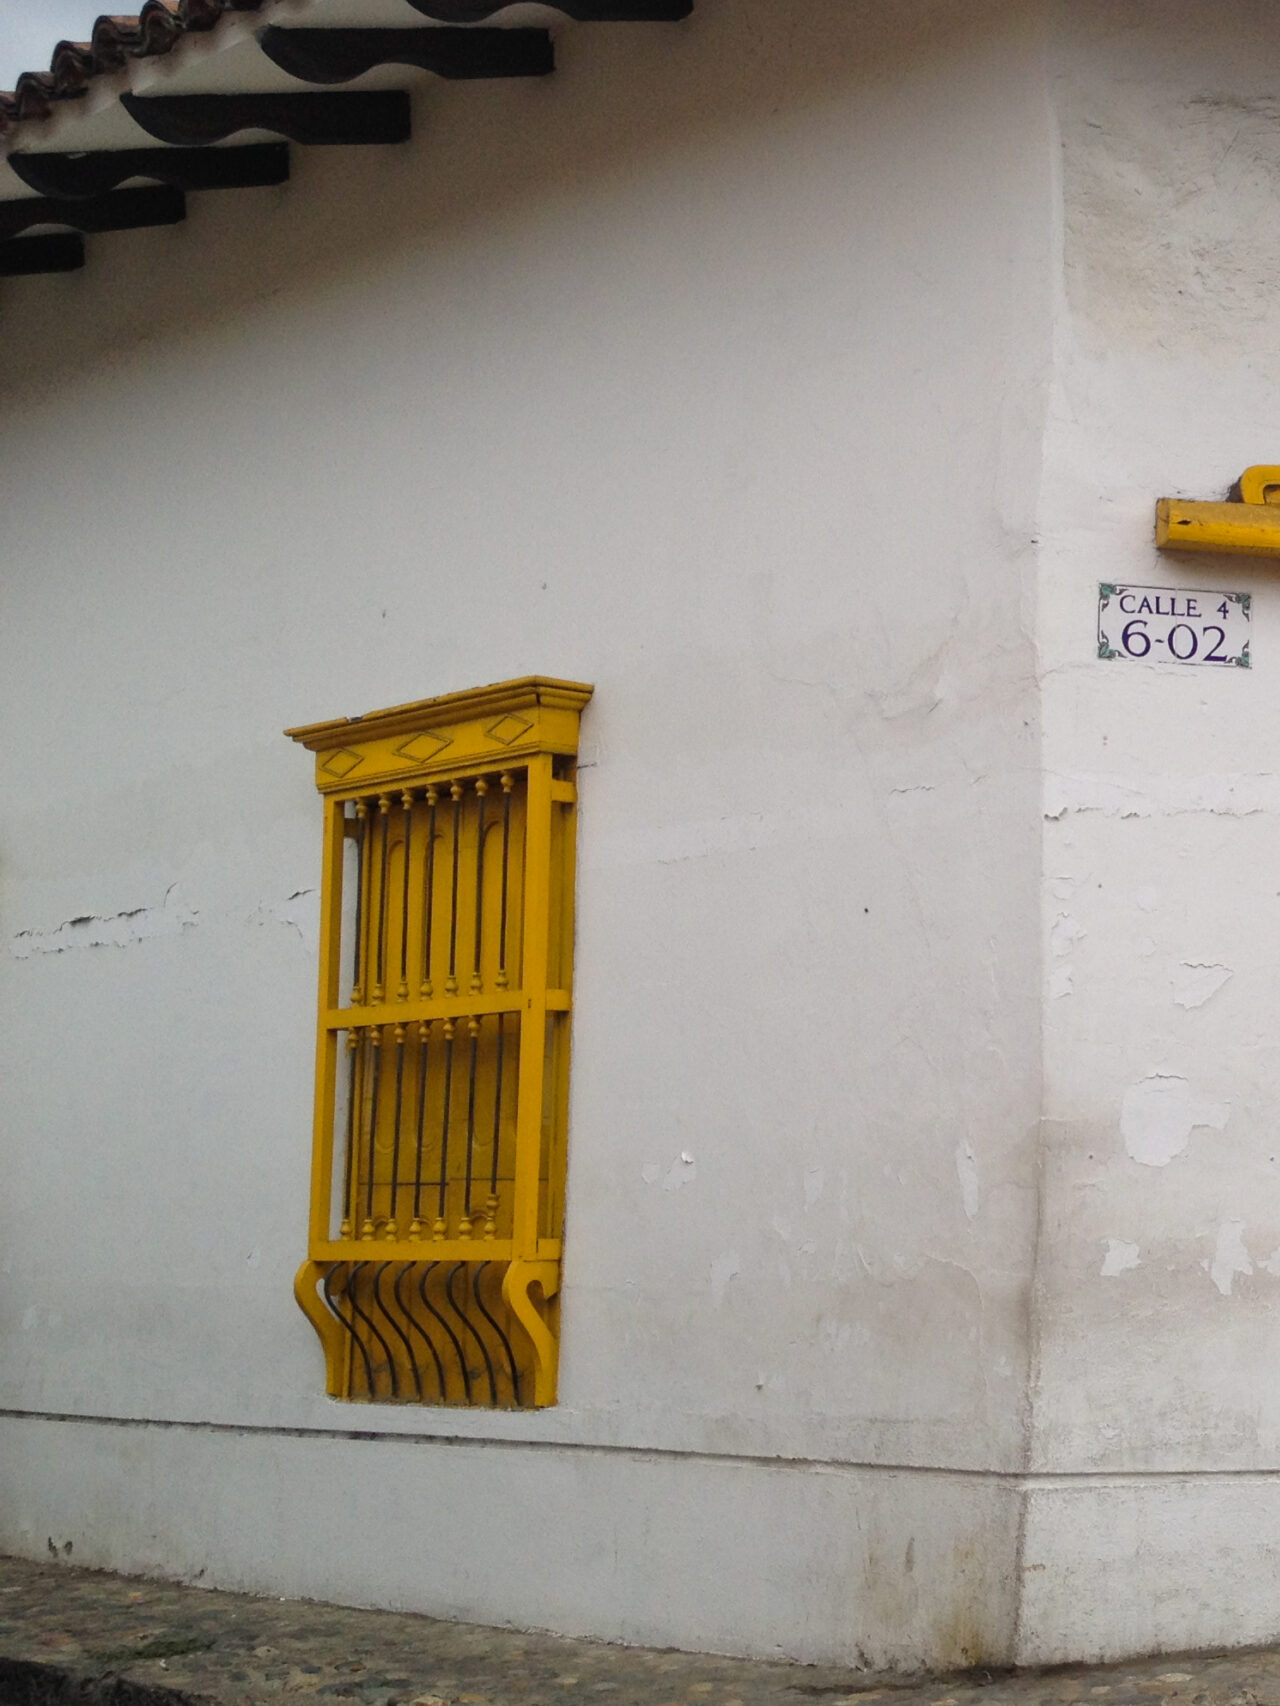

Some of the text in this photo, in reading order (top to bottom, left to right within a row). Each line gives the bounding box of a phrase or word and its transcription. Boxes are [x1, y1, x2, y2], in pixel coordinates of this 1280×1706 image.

[1119, 594, 1229, 620] CALLE 4
[1121, 619, 1228, 662] 6-02
